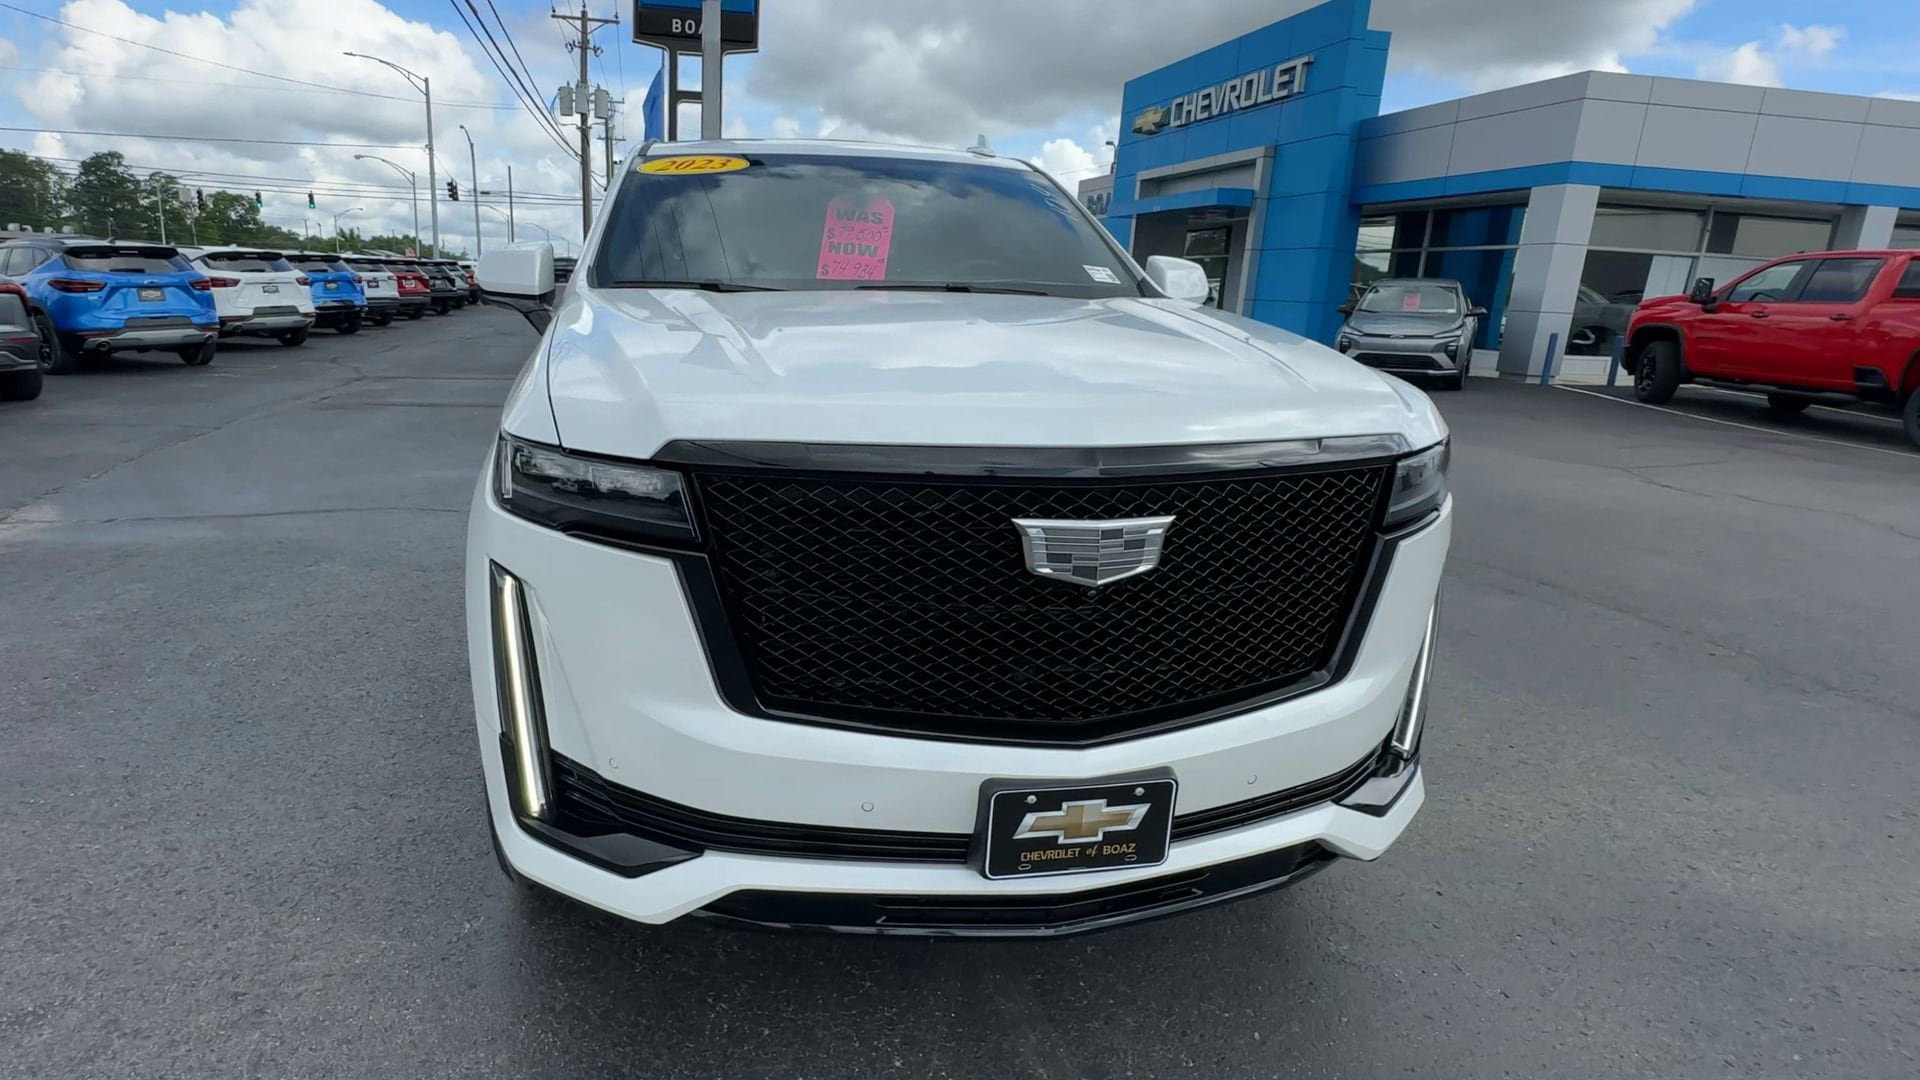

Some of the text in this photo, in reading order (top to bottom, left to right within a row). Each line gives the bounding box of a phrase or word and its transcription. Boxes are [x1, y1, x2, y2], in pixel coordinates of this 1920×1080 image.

[671, 18, 702, 34] BO
[1170, 55, 1313, 128] CHEVROLET
[655, 159, 732, 172] 2023
[835, 208, 884, 225] WAS
[828, 241, 879, 258] NOW
[1020, 843, 1136, 862] CHEVROLET of BOAZ
